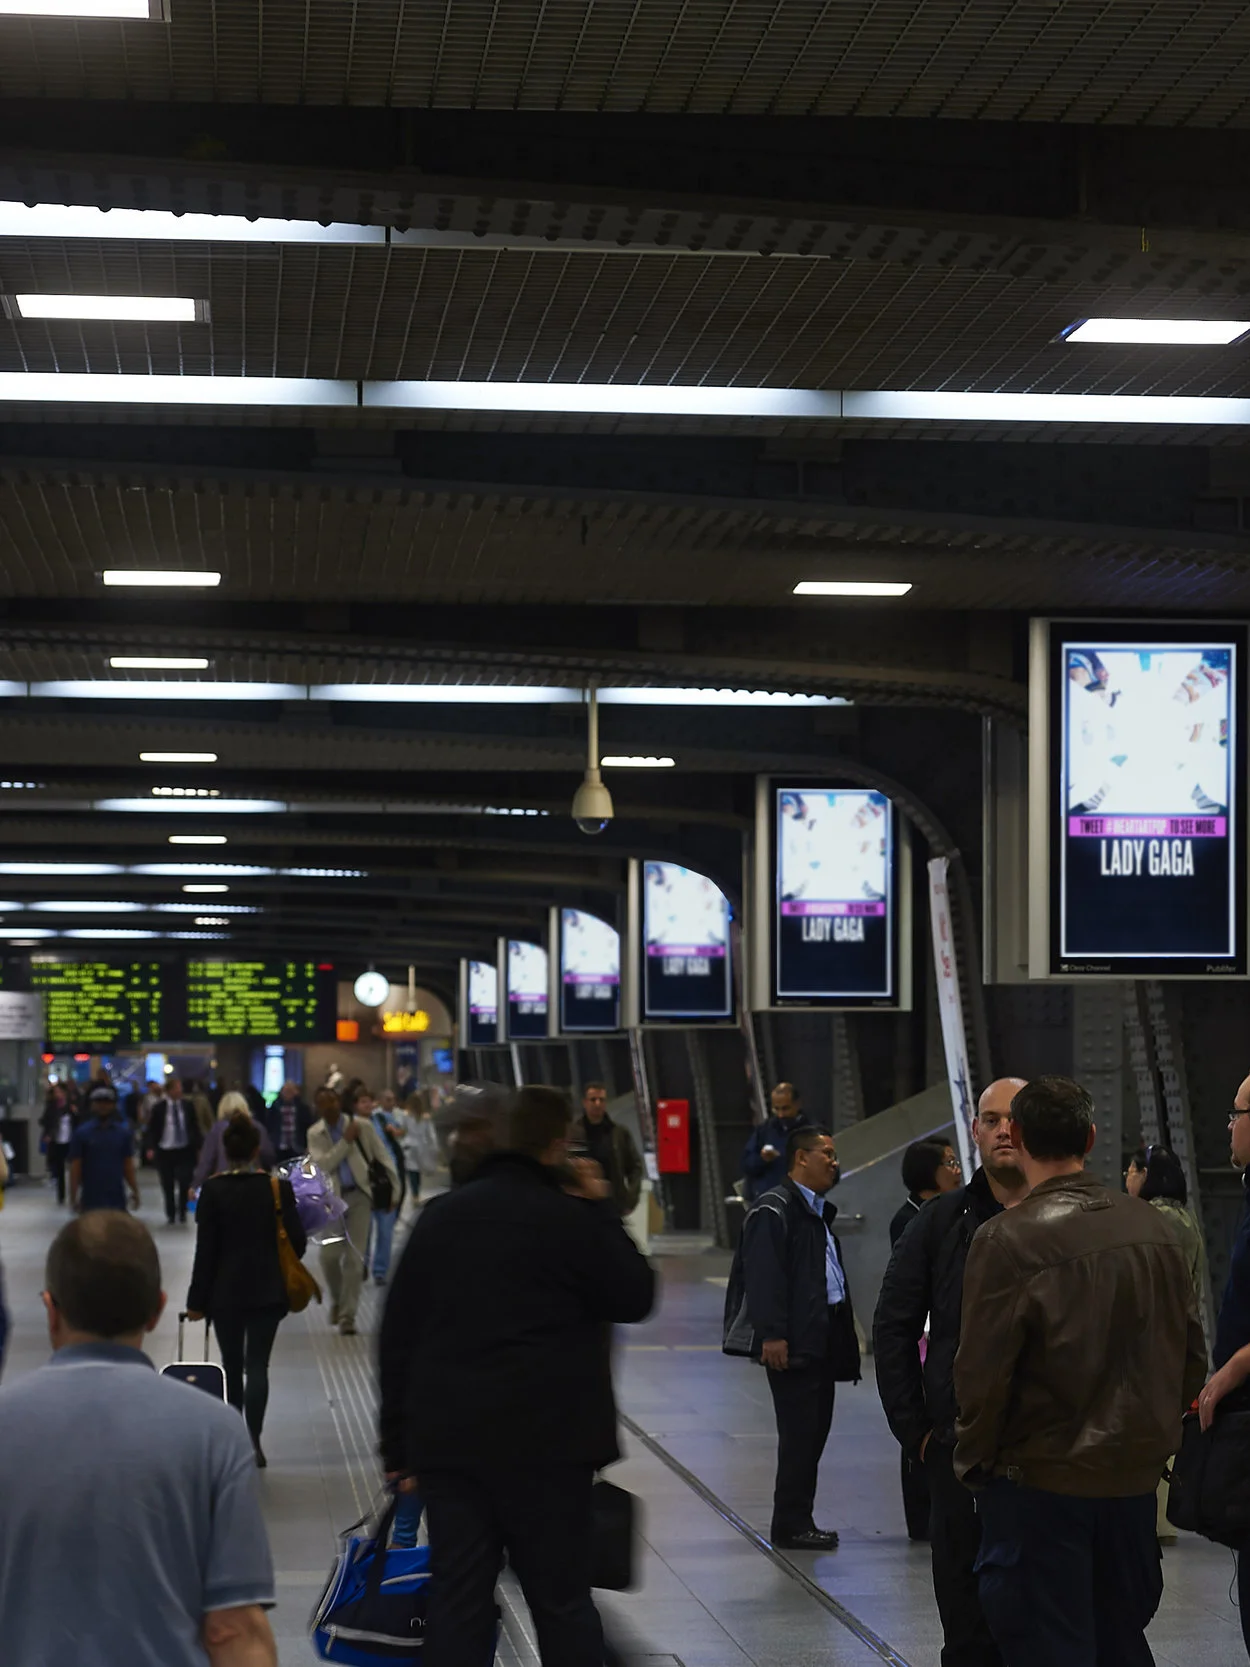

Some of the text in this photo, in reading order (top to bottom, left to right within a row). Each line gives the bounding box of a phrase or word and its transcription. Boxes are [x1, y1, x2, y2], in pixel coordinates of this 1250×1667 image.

[1100, 839, 1195, 876] LADY GAGA
[802, 917, 865, 942] LADY GAGA
